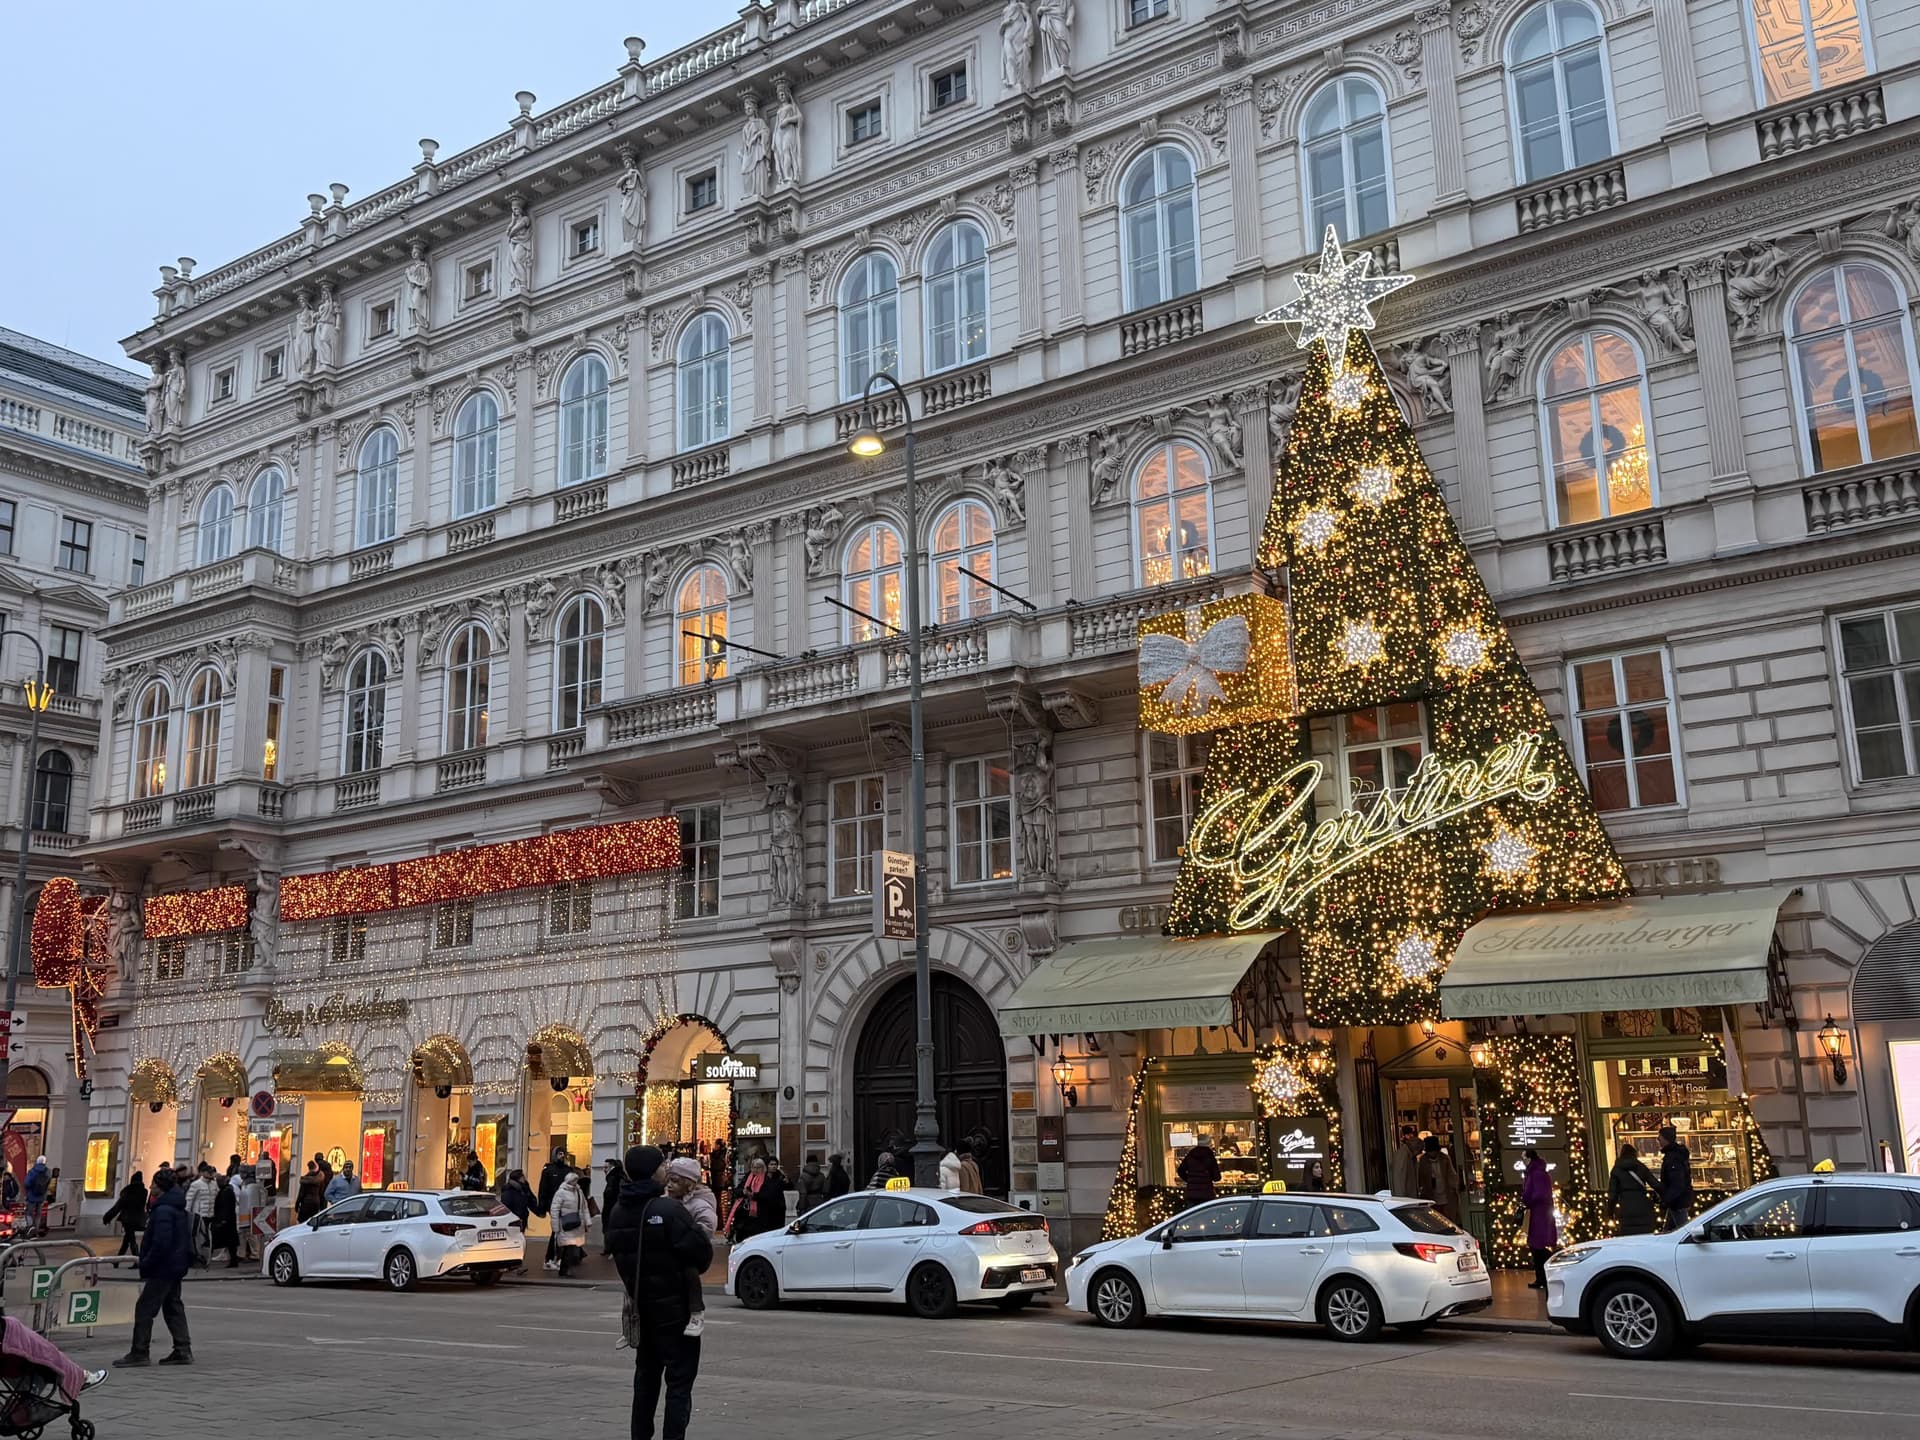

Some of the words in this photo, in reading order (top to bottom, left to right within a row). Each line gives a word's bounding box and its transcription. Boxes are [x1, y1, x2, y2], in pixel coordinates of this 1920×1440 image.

[1190, 732, 1556, 929] Gerstner
[889, 885, 904, 917] P
[1473, 918, 1754, 953] Schlumberger
[706, 1065, 757, 1078] SOUVENIR
[1640, 1084, 1665, 1097] Etage
[1686, 1083, 1707, 1093] floor
[737, 1126, 772, 1136] SOUVENIR
[69, 1293, 92, 1322] P
